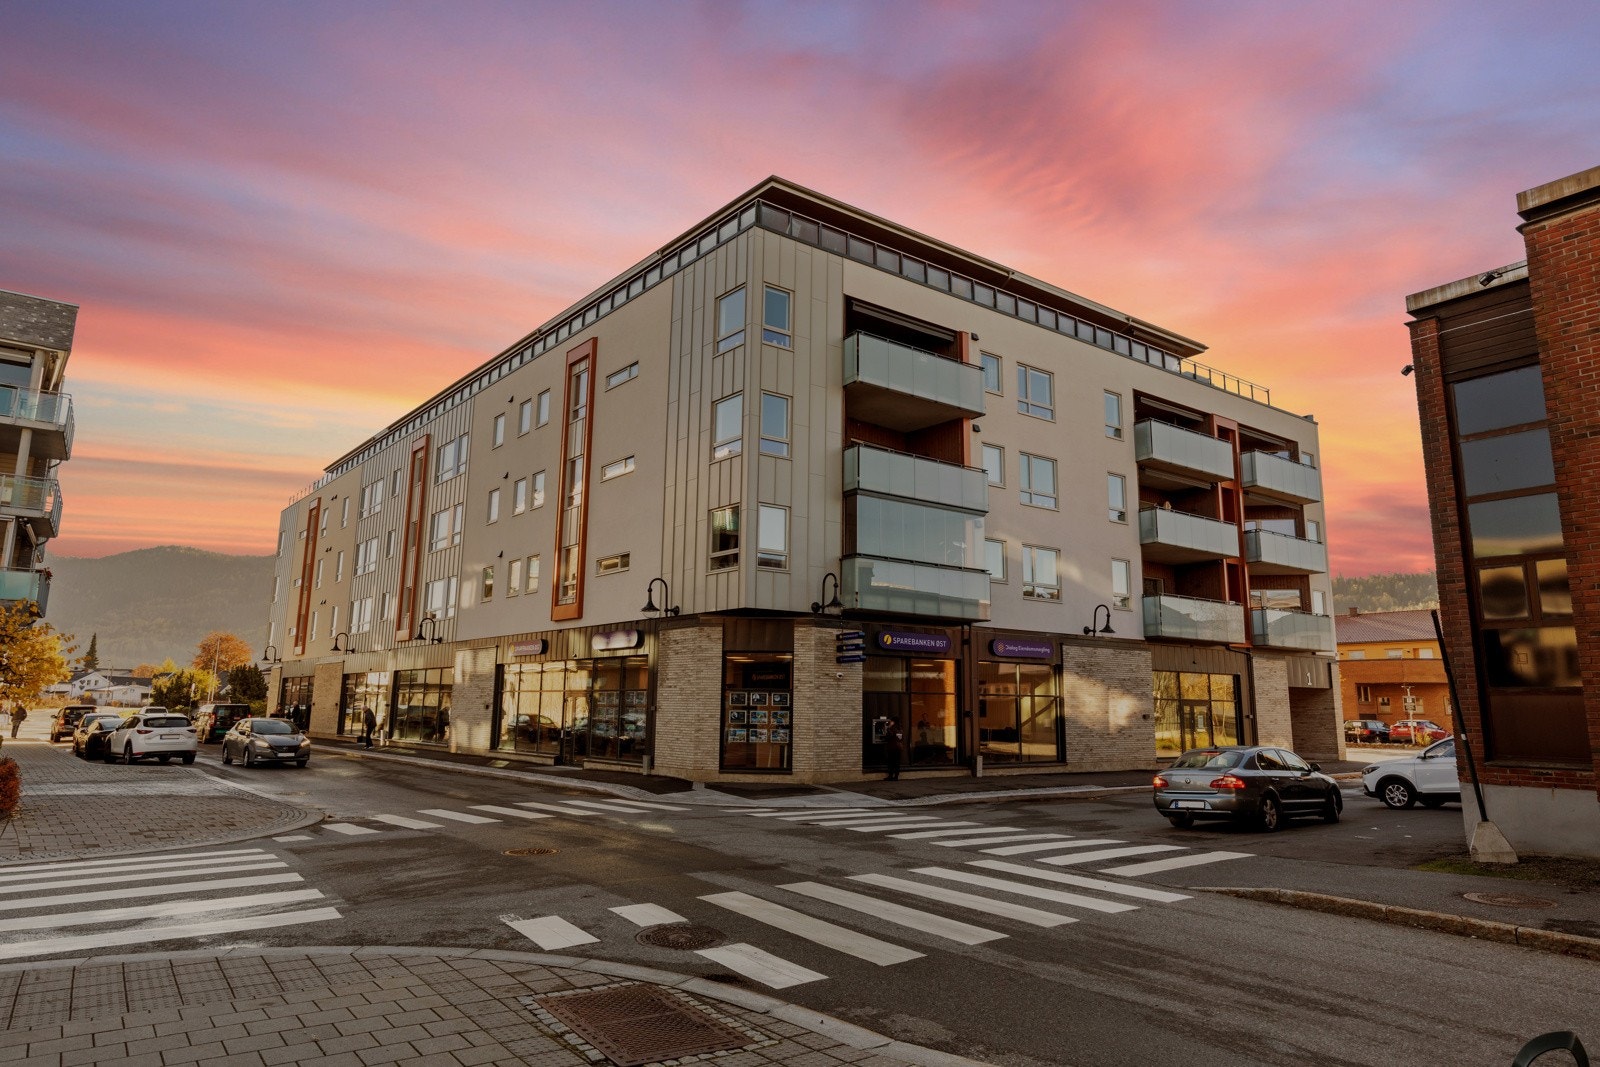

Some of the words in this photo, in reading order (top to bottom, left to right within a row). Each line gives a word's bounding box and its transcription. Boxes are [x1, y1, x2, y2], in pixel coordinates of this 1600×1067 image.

[892, 637, 935, 647] SPAREBANKEN
[935, 640, 947, 648] ØST
[1306, 672, 1312, 686] 1
